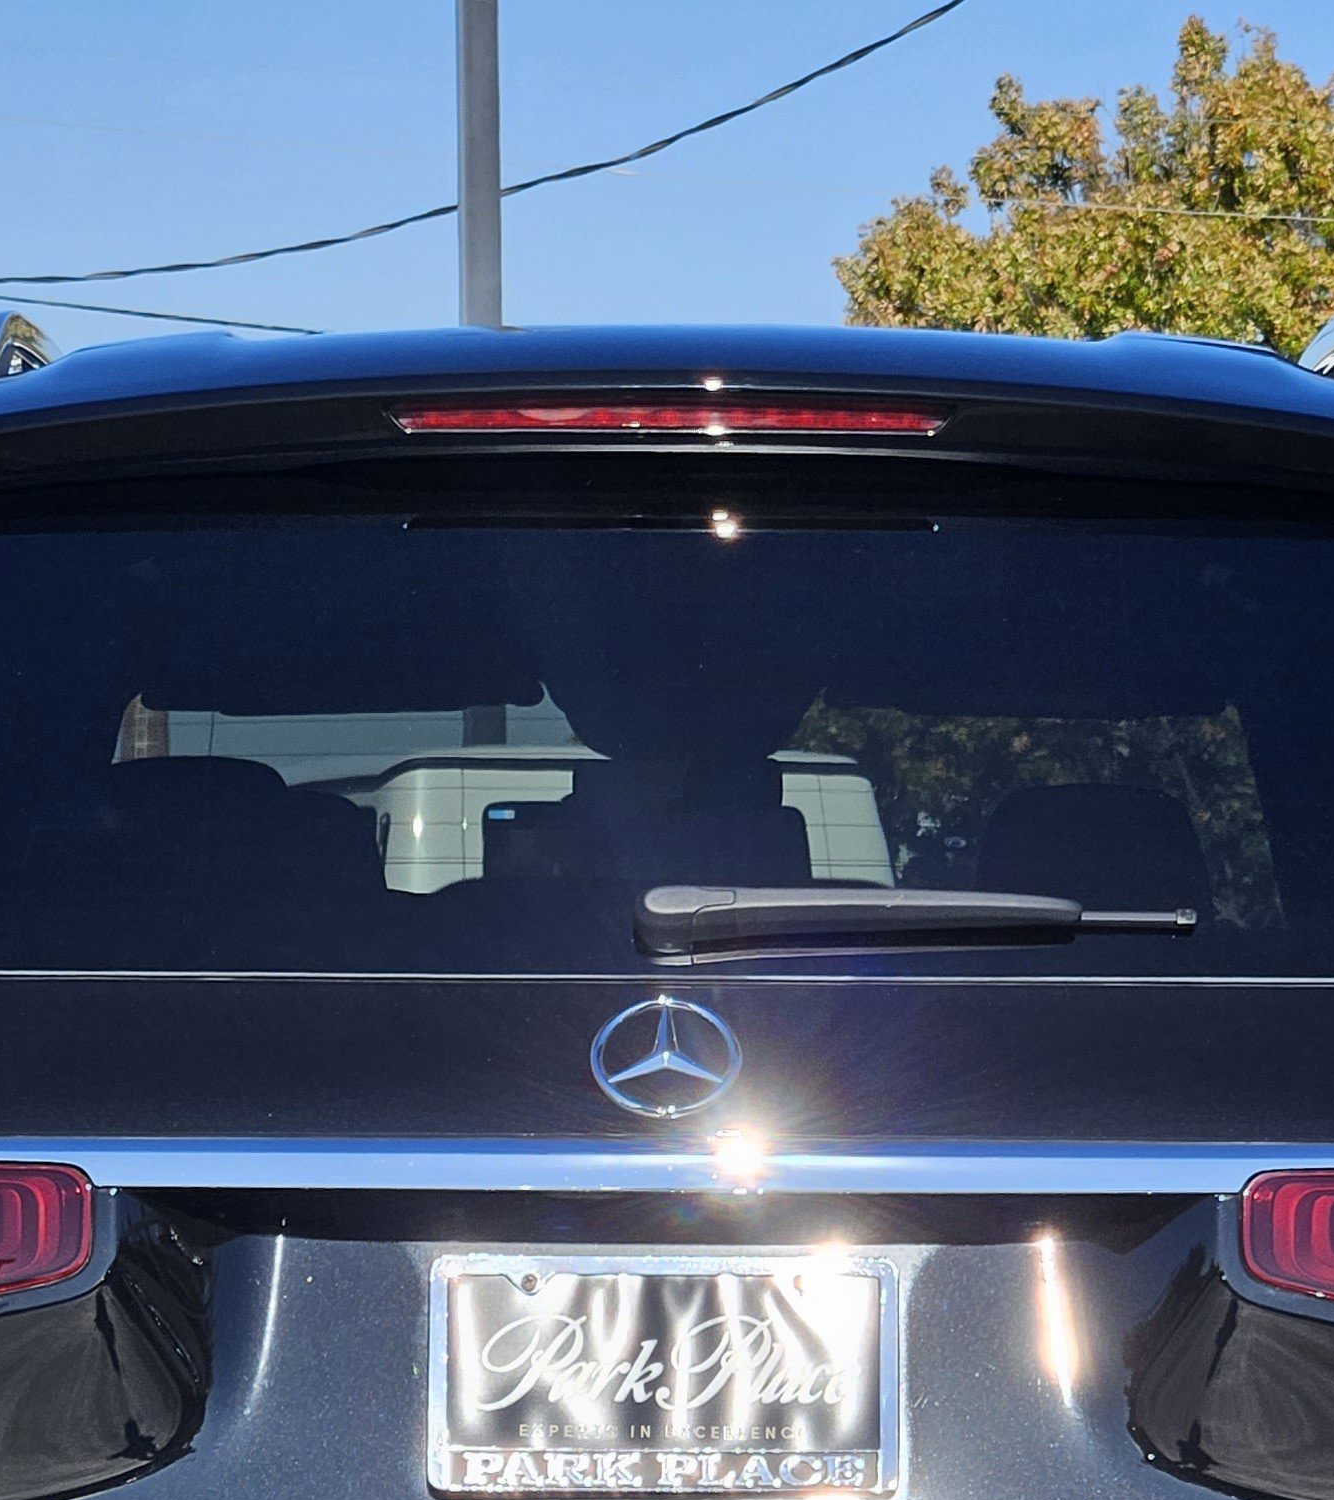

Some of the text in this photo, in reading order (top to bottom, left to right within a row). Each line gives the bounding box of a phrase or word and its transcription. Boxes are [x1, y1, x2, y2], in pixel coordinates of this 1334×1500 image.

[473, 1313, 861, 1412] Park Place
[630, 1424, 652, 1439] IN
[463, 1451, 865, 1488] PARK PLACE
